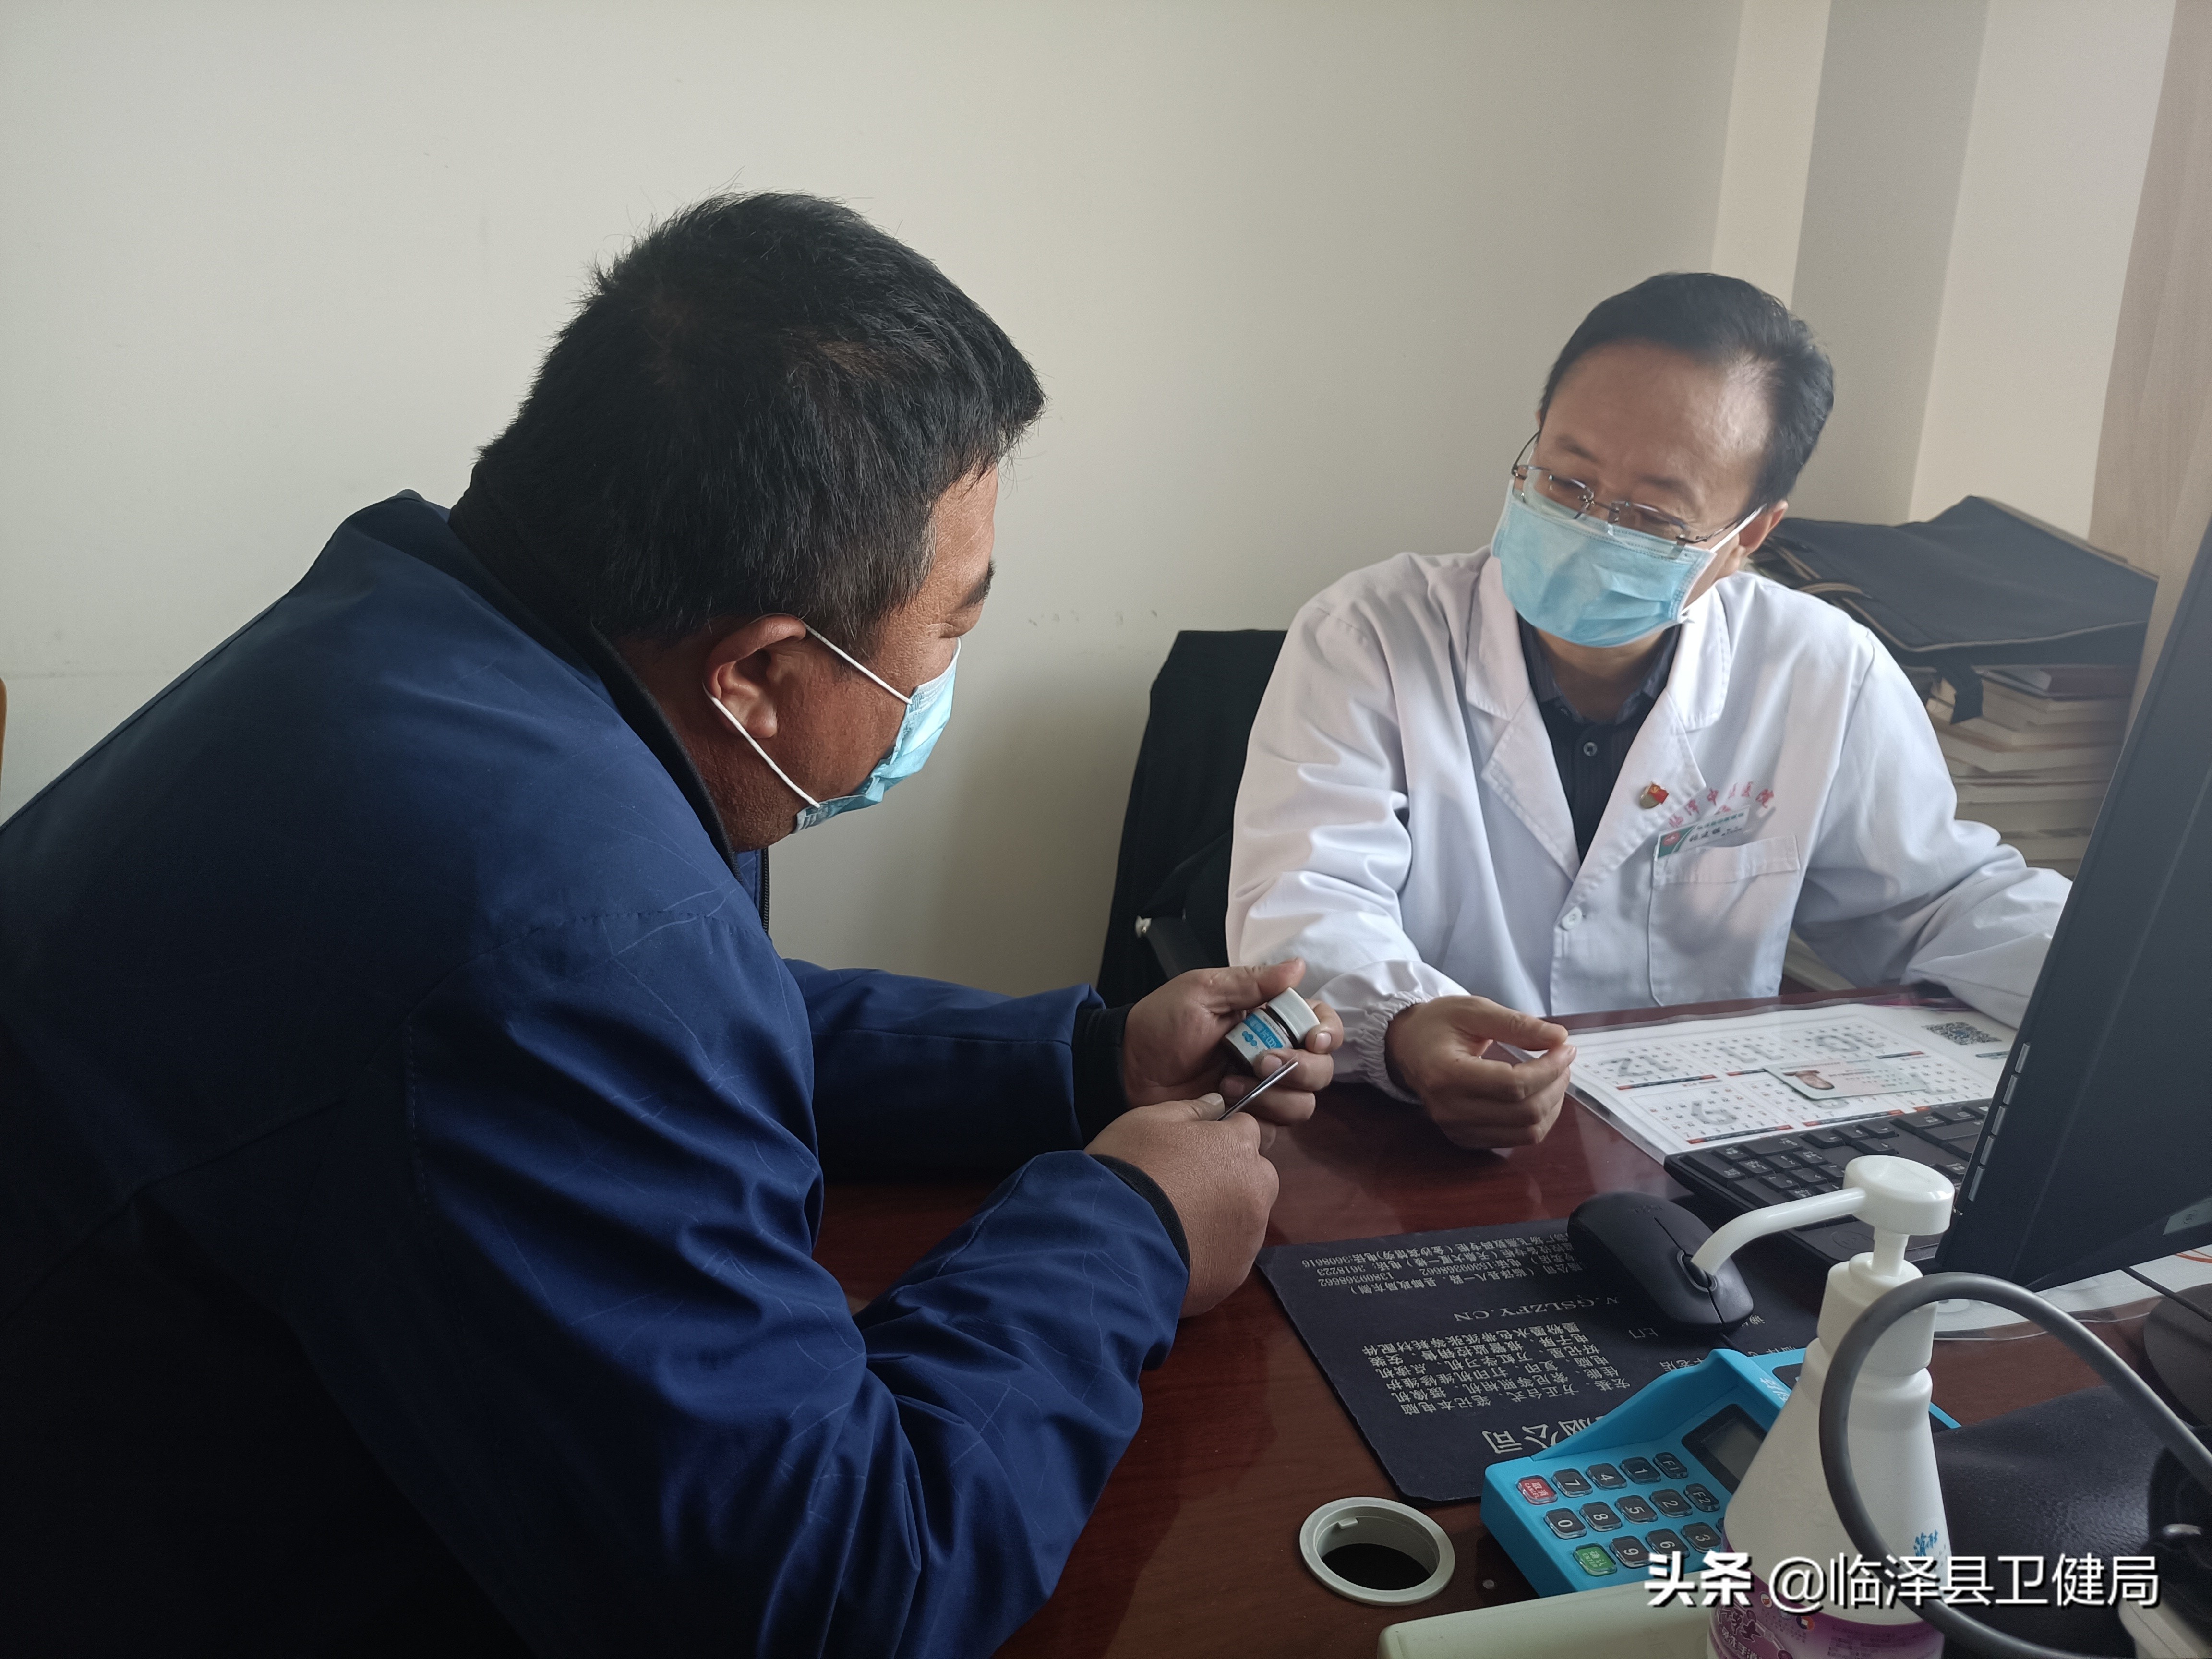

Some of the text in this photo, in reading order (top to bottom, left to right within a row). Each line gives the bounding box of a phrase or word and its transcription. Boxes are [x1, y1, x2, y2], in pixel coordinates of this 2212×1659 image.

[1662, 1460, 1680, 1471] F1
[1600, 1473, 1615, 1481] 4
[1693, 1491, 1711, 1504] F2
[1662, 1500, 1679, 1508] 2
[1628, 1506, 1645, 1514] 5
[1593, 1513, 1609, 1521] 8
[1557, 1519, 1573, 1527] 0
[1695, 1534, 1711, 1542] 3
[1659, 1540, 1675, 1549] 6
